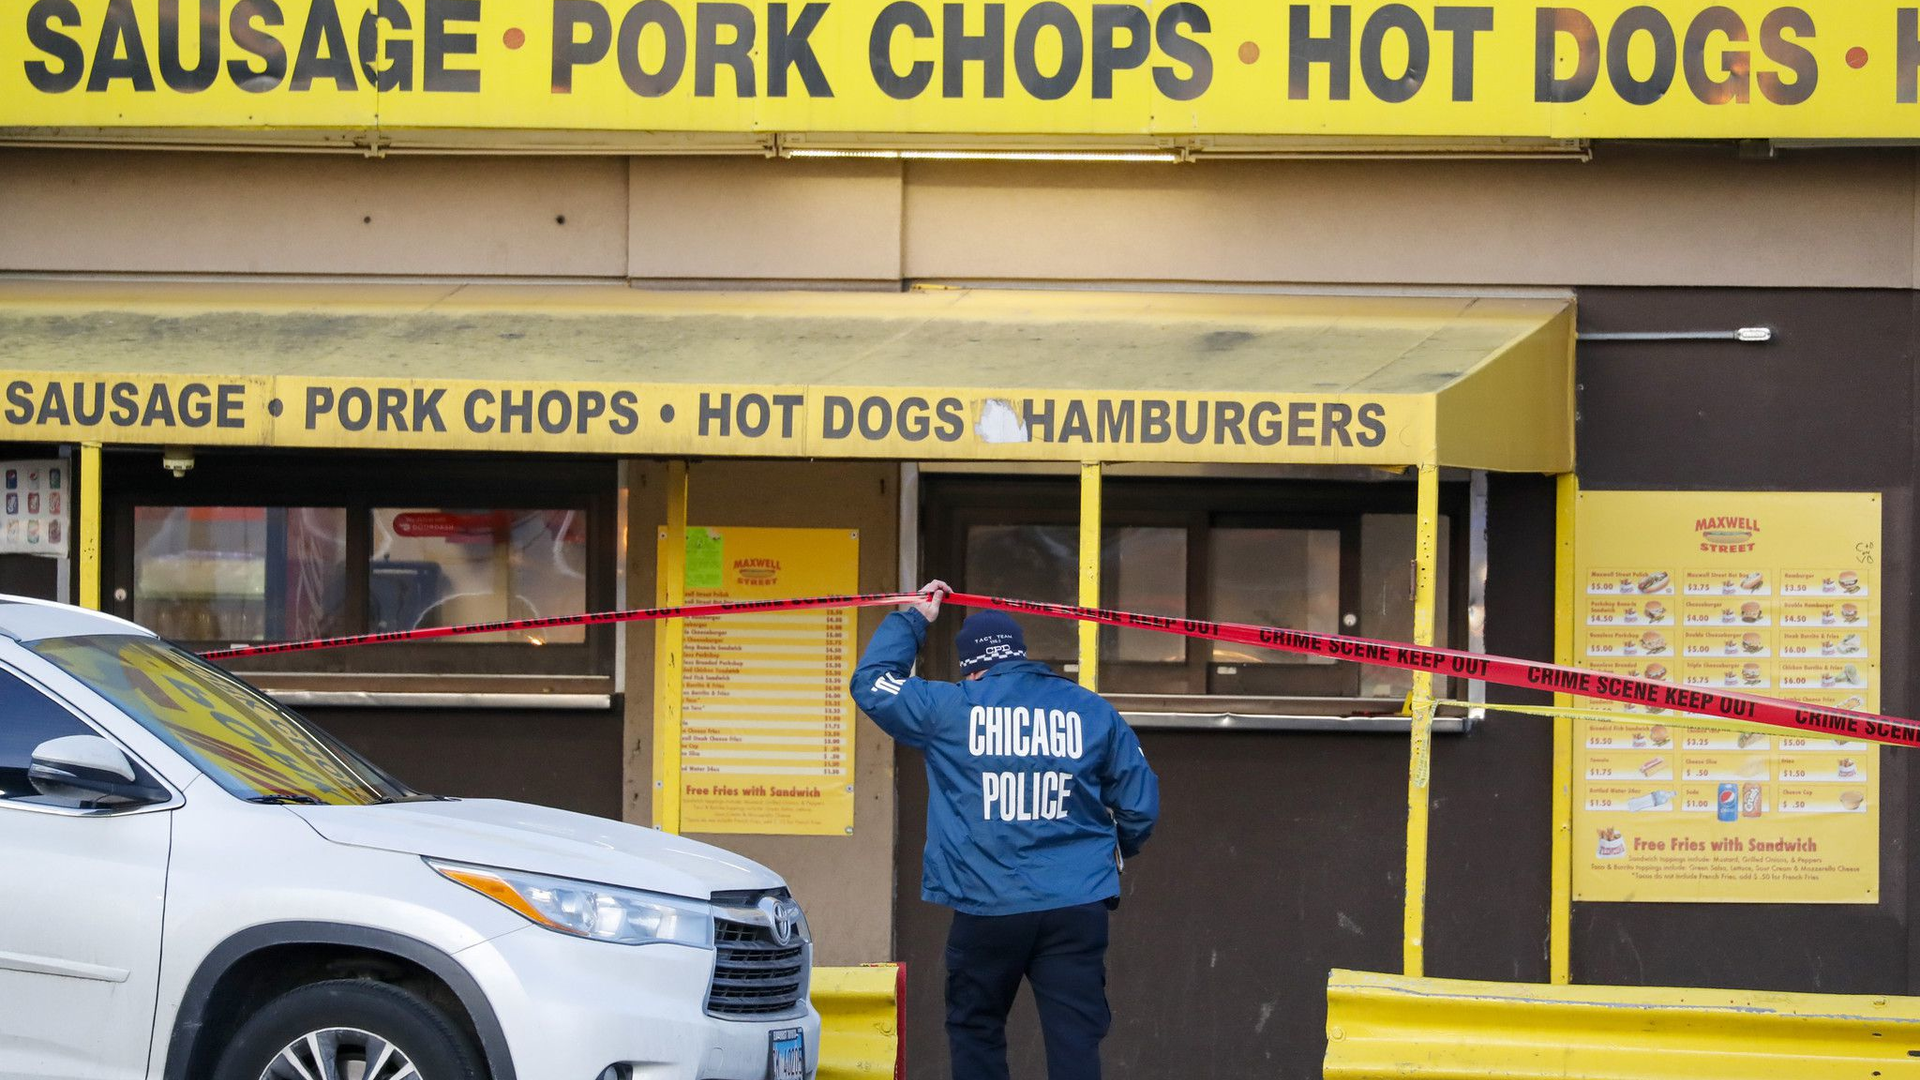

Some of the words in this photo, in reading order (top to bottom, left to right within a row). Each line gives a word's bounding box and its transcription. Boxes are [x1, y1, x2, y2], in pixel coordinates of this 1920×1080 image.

[25, 0, 480, 94] SAUSAGE
[551, 0, 834, 98] PORK
[869, 1, 1213, 100] CHOPS
[1288, 4, 1494, 103] HOT
[1535, 6, 1818, 105] DOGS
[3, 381, 246, 428] SAUSAGE
[305, 386, 447, 432] PORK
[464, 389, 638, 435] CHOPS
[699, 393, 803, 438] HOT
[822, 396, 963, 441] DOGS
[1025, 399, 1386, 448] HAMBURGERS
[1695, 516, 1760, 532] MAXWELL
[1700, 543, 1755, 553] STREET
[733, 558, 781, 570] MAXWELL
[737, 578, 777, 586] STREET
[1688, 583, 1709, 591] $3.75
[1184, 619, 1220, 635] OUT
[985, 644, 1010, 655] CPD
[1259, 627, 1323, 652] CRIME
[1329, 635, 1390, 662] SCENE
[1397, 647, 1446, 669] KEEP
[1452, 655, 1491, 677] OUT
[1528, 666, 1590, 692] CRIME
[1597, 675, 1660, 702] SCENE
[1665, 686, 1713, 709] KEEP
[1720, 697, 1756, 717] OUT
[967, 706, 1083, 759] CHICAGO
[1795, 706, 1858, 732] CRIME
[1865, 717, 1920, 743] SCEN
[686, 785, 709, 795] Free
[713, 785, 738, 796] Fries
[742, 786, 766, 796] with
[770, 786, 820, 797] Sandwich
[982, 771, 1073, 821] POLICE
[1634, 837, 1665, 851] Free
[1671, 837, 1705, 851] Fries
[1711, 837, 1743, 851] with
[1749, 837, 1816, 852] Sandwich
